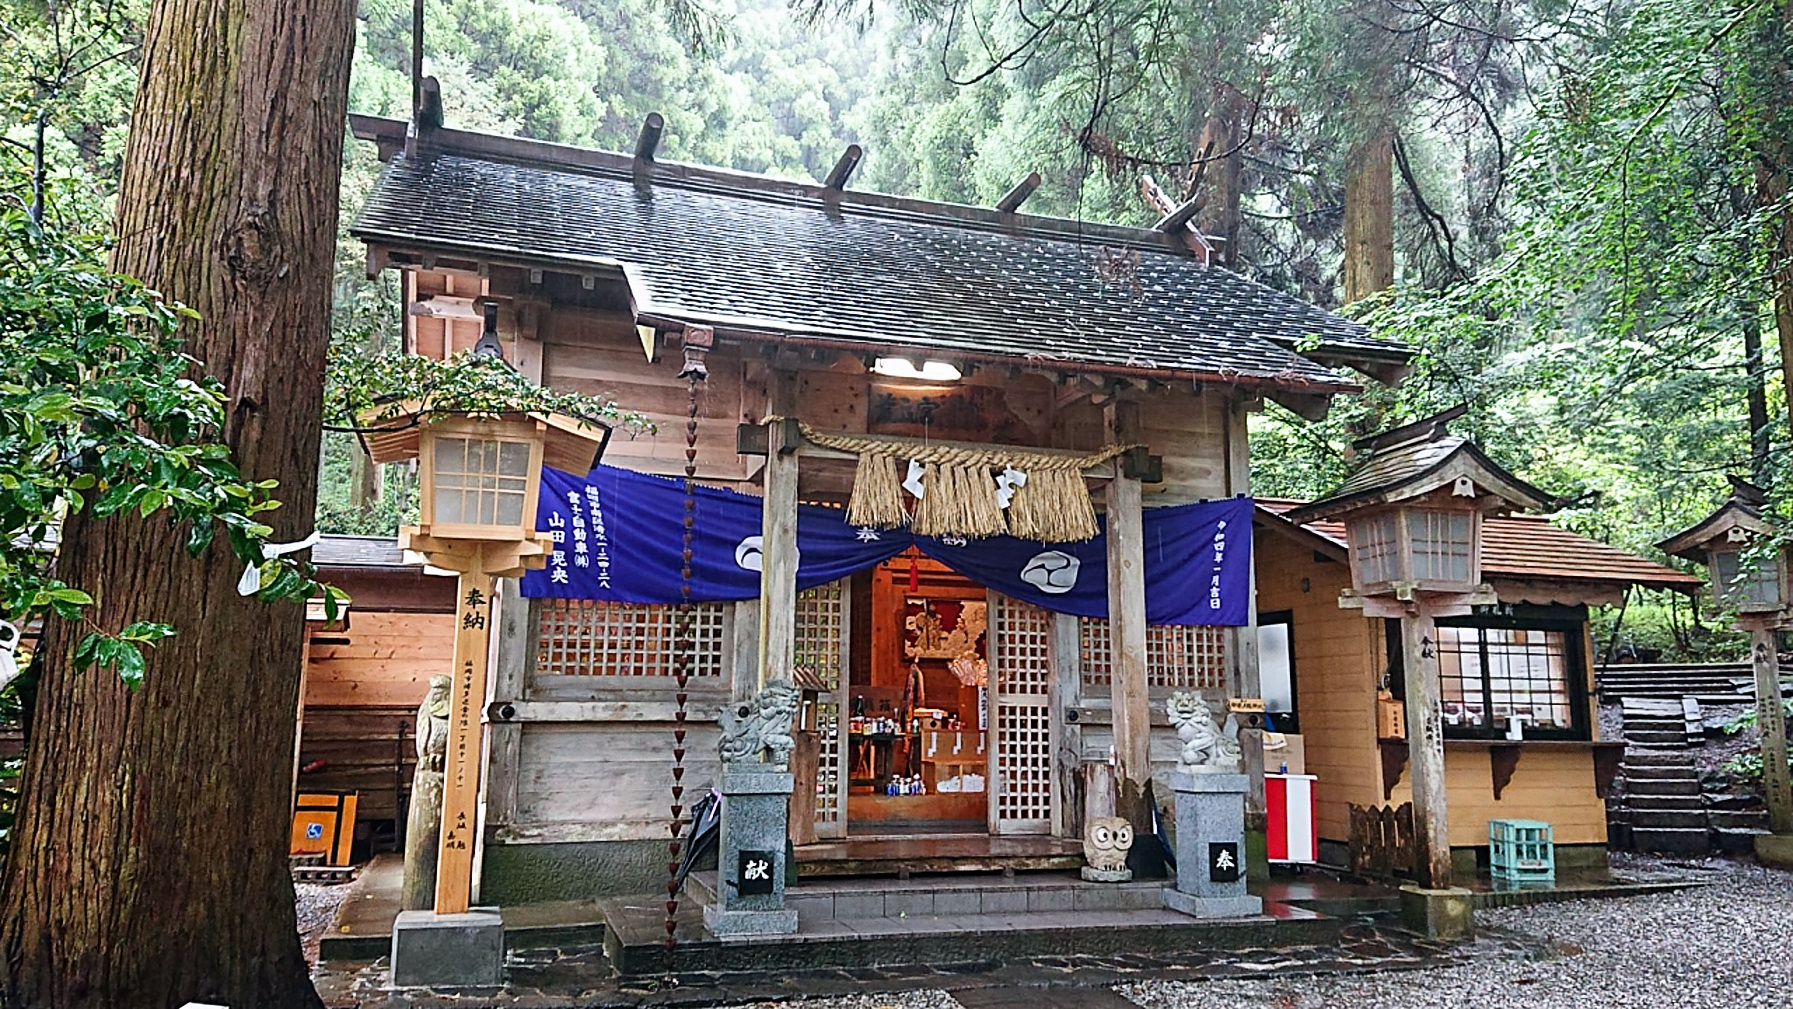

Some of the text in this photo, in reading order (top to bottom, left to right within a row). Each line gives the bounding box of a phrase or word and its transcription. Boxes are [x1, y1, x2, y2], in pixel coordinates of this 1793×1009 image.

[1209, 520, 1227, 609] 令和四年一月吉日
[463, 587, 487, 630] 奉納
[744, 859, 770, 881] 献
[1215, 850, 1236, 871] 奉
